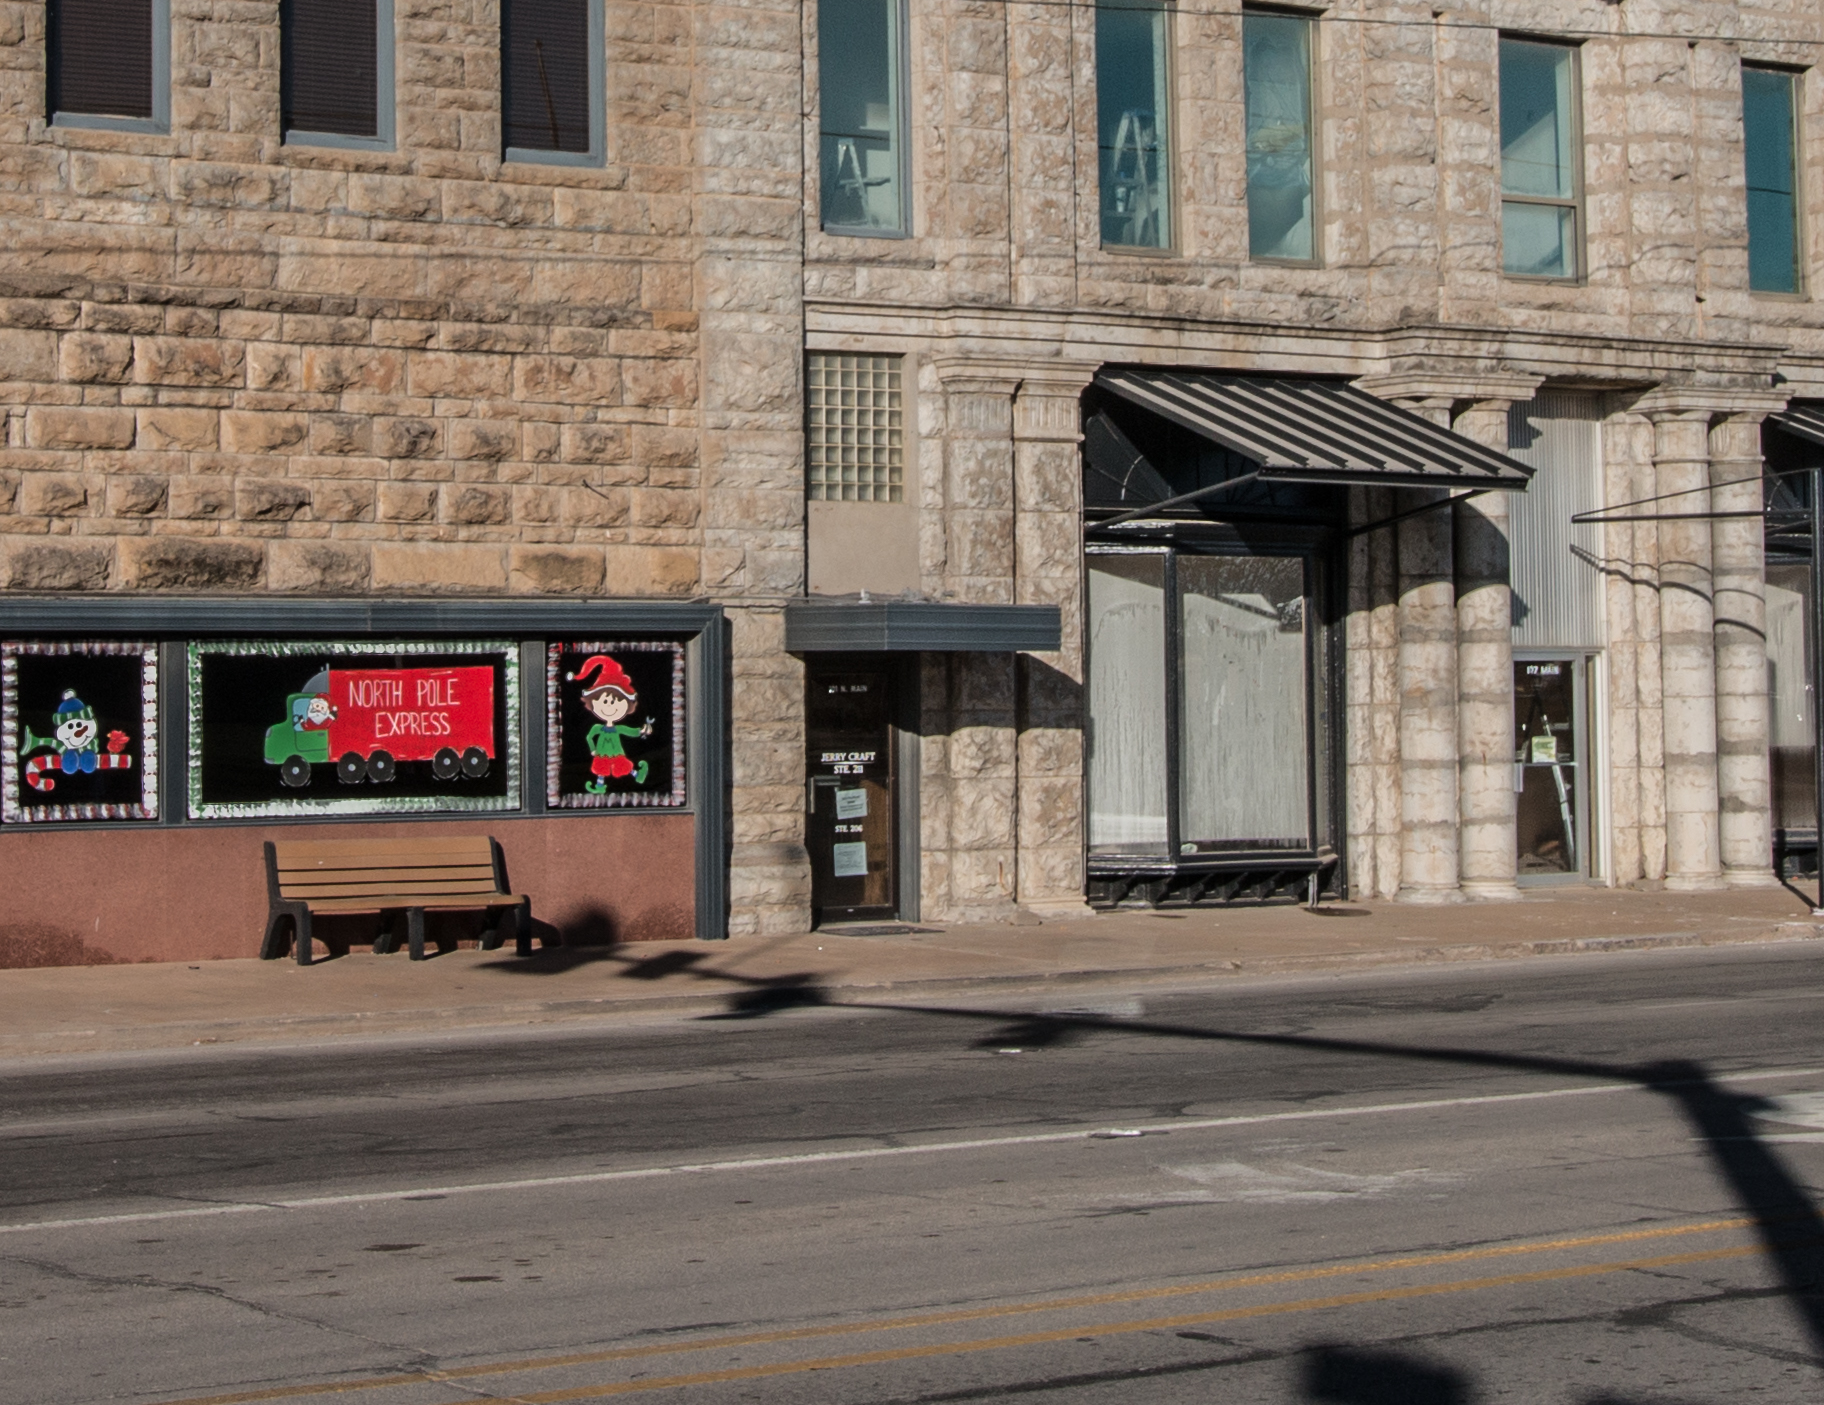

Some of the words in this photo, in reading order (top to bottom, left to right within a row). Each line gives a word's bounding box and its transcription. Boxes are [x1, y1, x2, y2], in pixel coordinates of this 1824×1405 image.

[349, 679, 403, 708] NORTH
[416, 678, 461, 707] POLE
[375, 711, 451, 738] EXPRESS
[821, 752, 847, 762] JERRY
[847, 751, 876, 761] CRAFT
